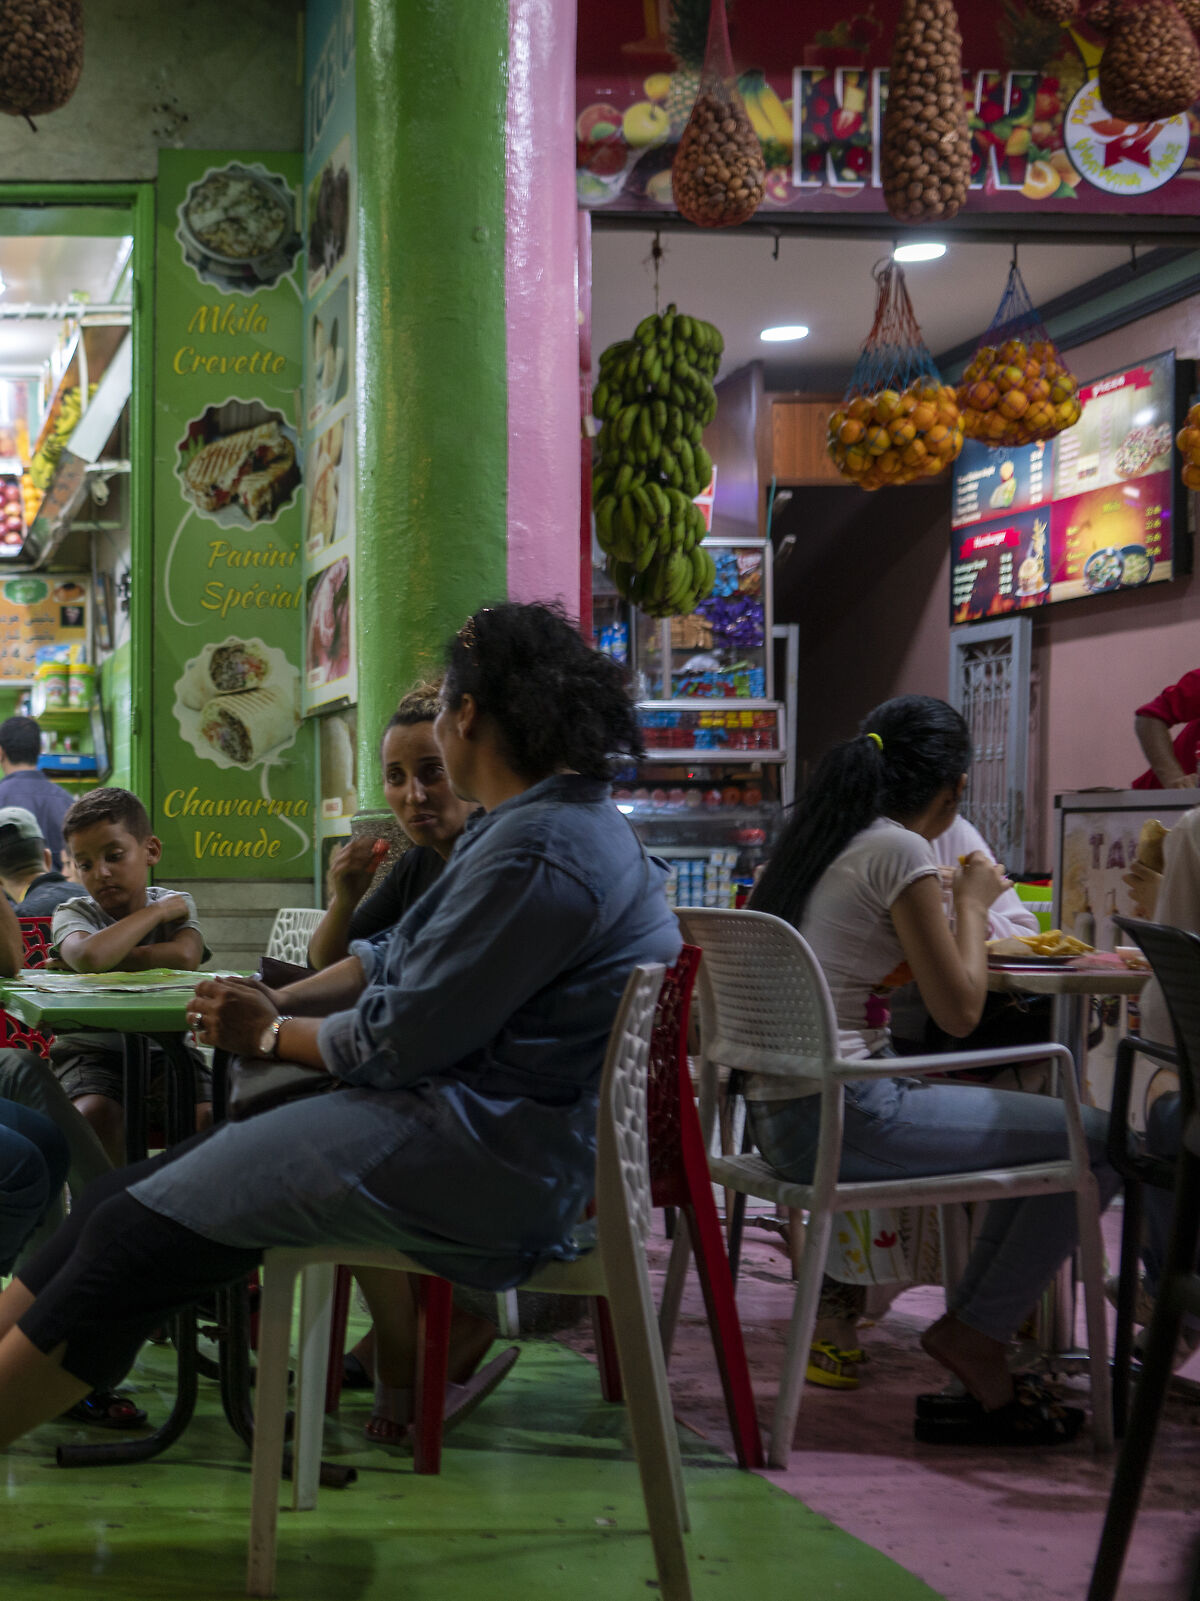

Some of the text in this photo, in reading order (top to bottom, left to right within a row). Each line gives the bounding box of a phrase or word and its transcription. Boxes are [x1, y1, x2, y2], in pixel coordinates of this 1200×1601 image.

[188, 303, 269, 336] Mkila
[173, 346, 286, 376] Crevette
[208, 540, 300, 570] Panini
[200, 582, 303, 617] Spécial
[164, 787, 309, 818] Chawarma
[194, 829, 282, 860] Viande
